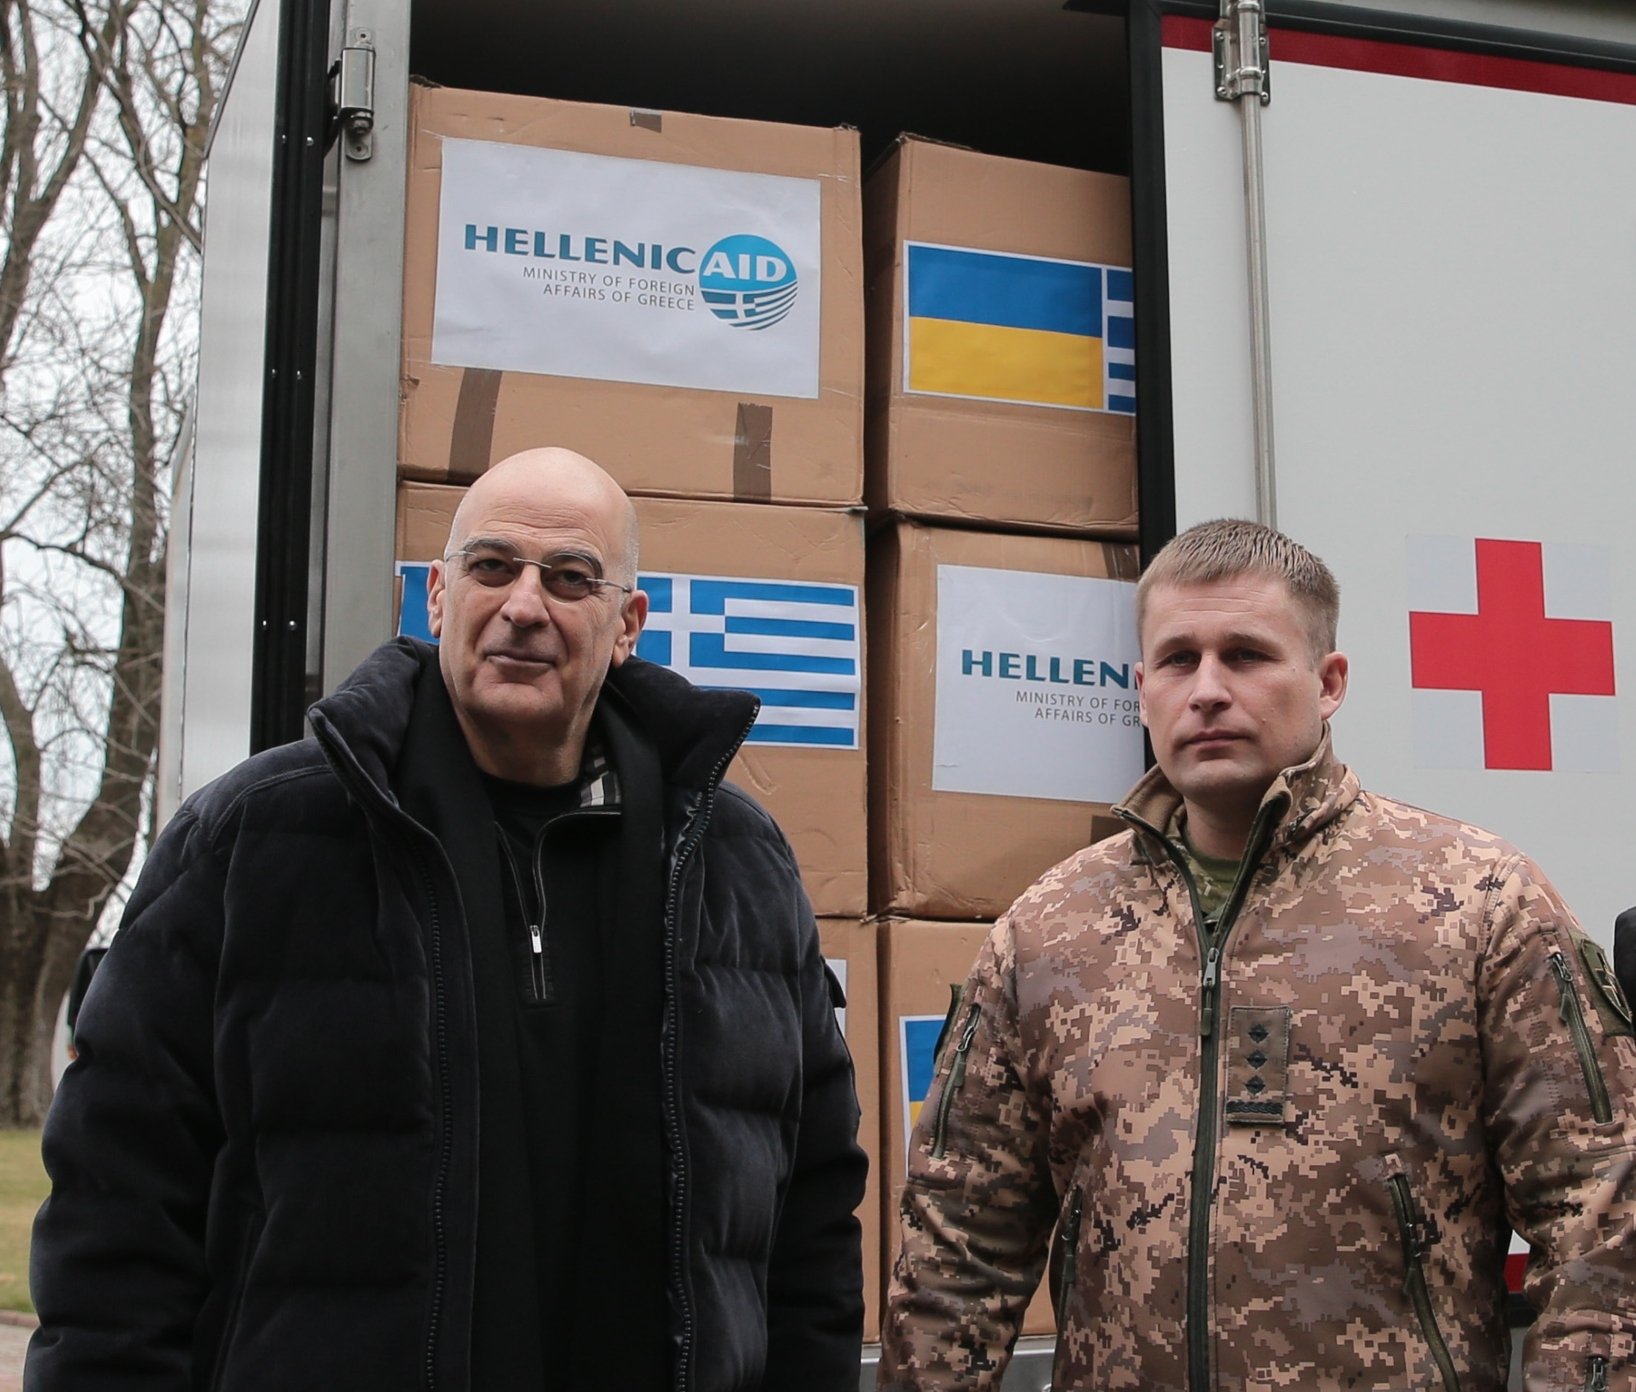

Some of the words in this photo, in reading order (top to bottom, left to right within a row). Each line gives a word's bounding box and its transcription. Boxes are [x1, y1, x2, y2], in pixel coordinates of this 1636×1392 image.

[464, 223, 696, 274] HELLENIC
[702, 251, 788, 282] AID
[522, 266, 597, 285] MINISTRY
[602, 274, 622, 287] OF
[629, 278, 695, 296] FOREIGN
[543, 283, 606, 301] AFFAIRS
[611, 290, 632, 303] OF
[637, 293, 695, 311] GREECE
[1016, 690, 1085, 708] MINISTRY
[1089, 697, 1108, 709] OF
[1035, 707, 1092, 723] AFFAIRS
[1098, 712, 1117, 725] OF
